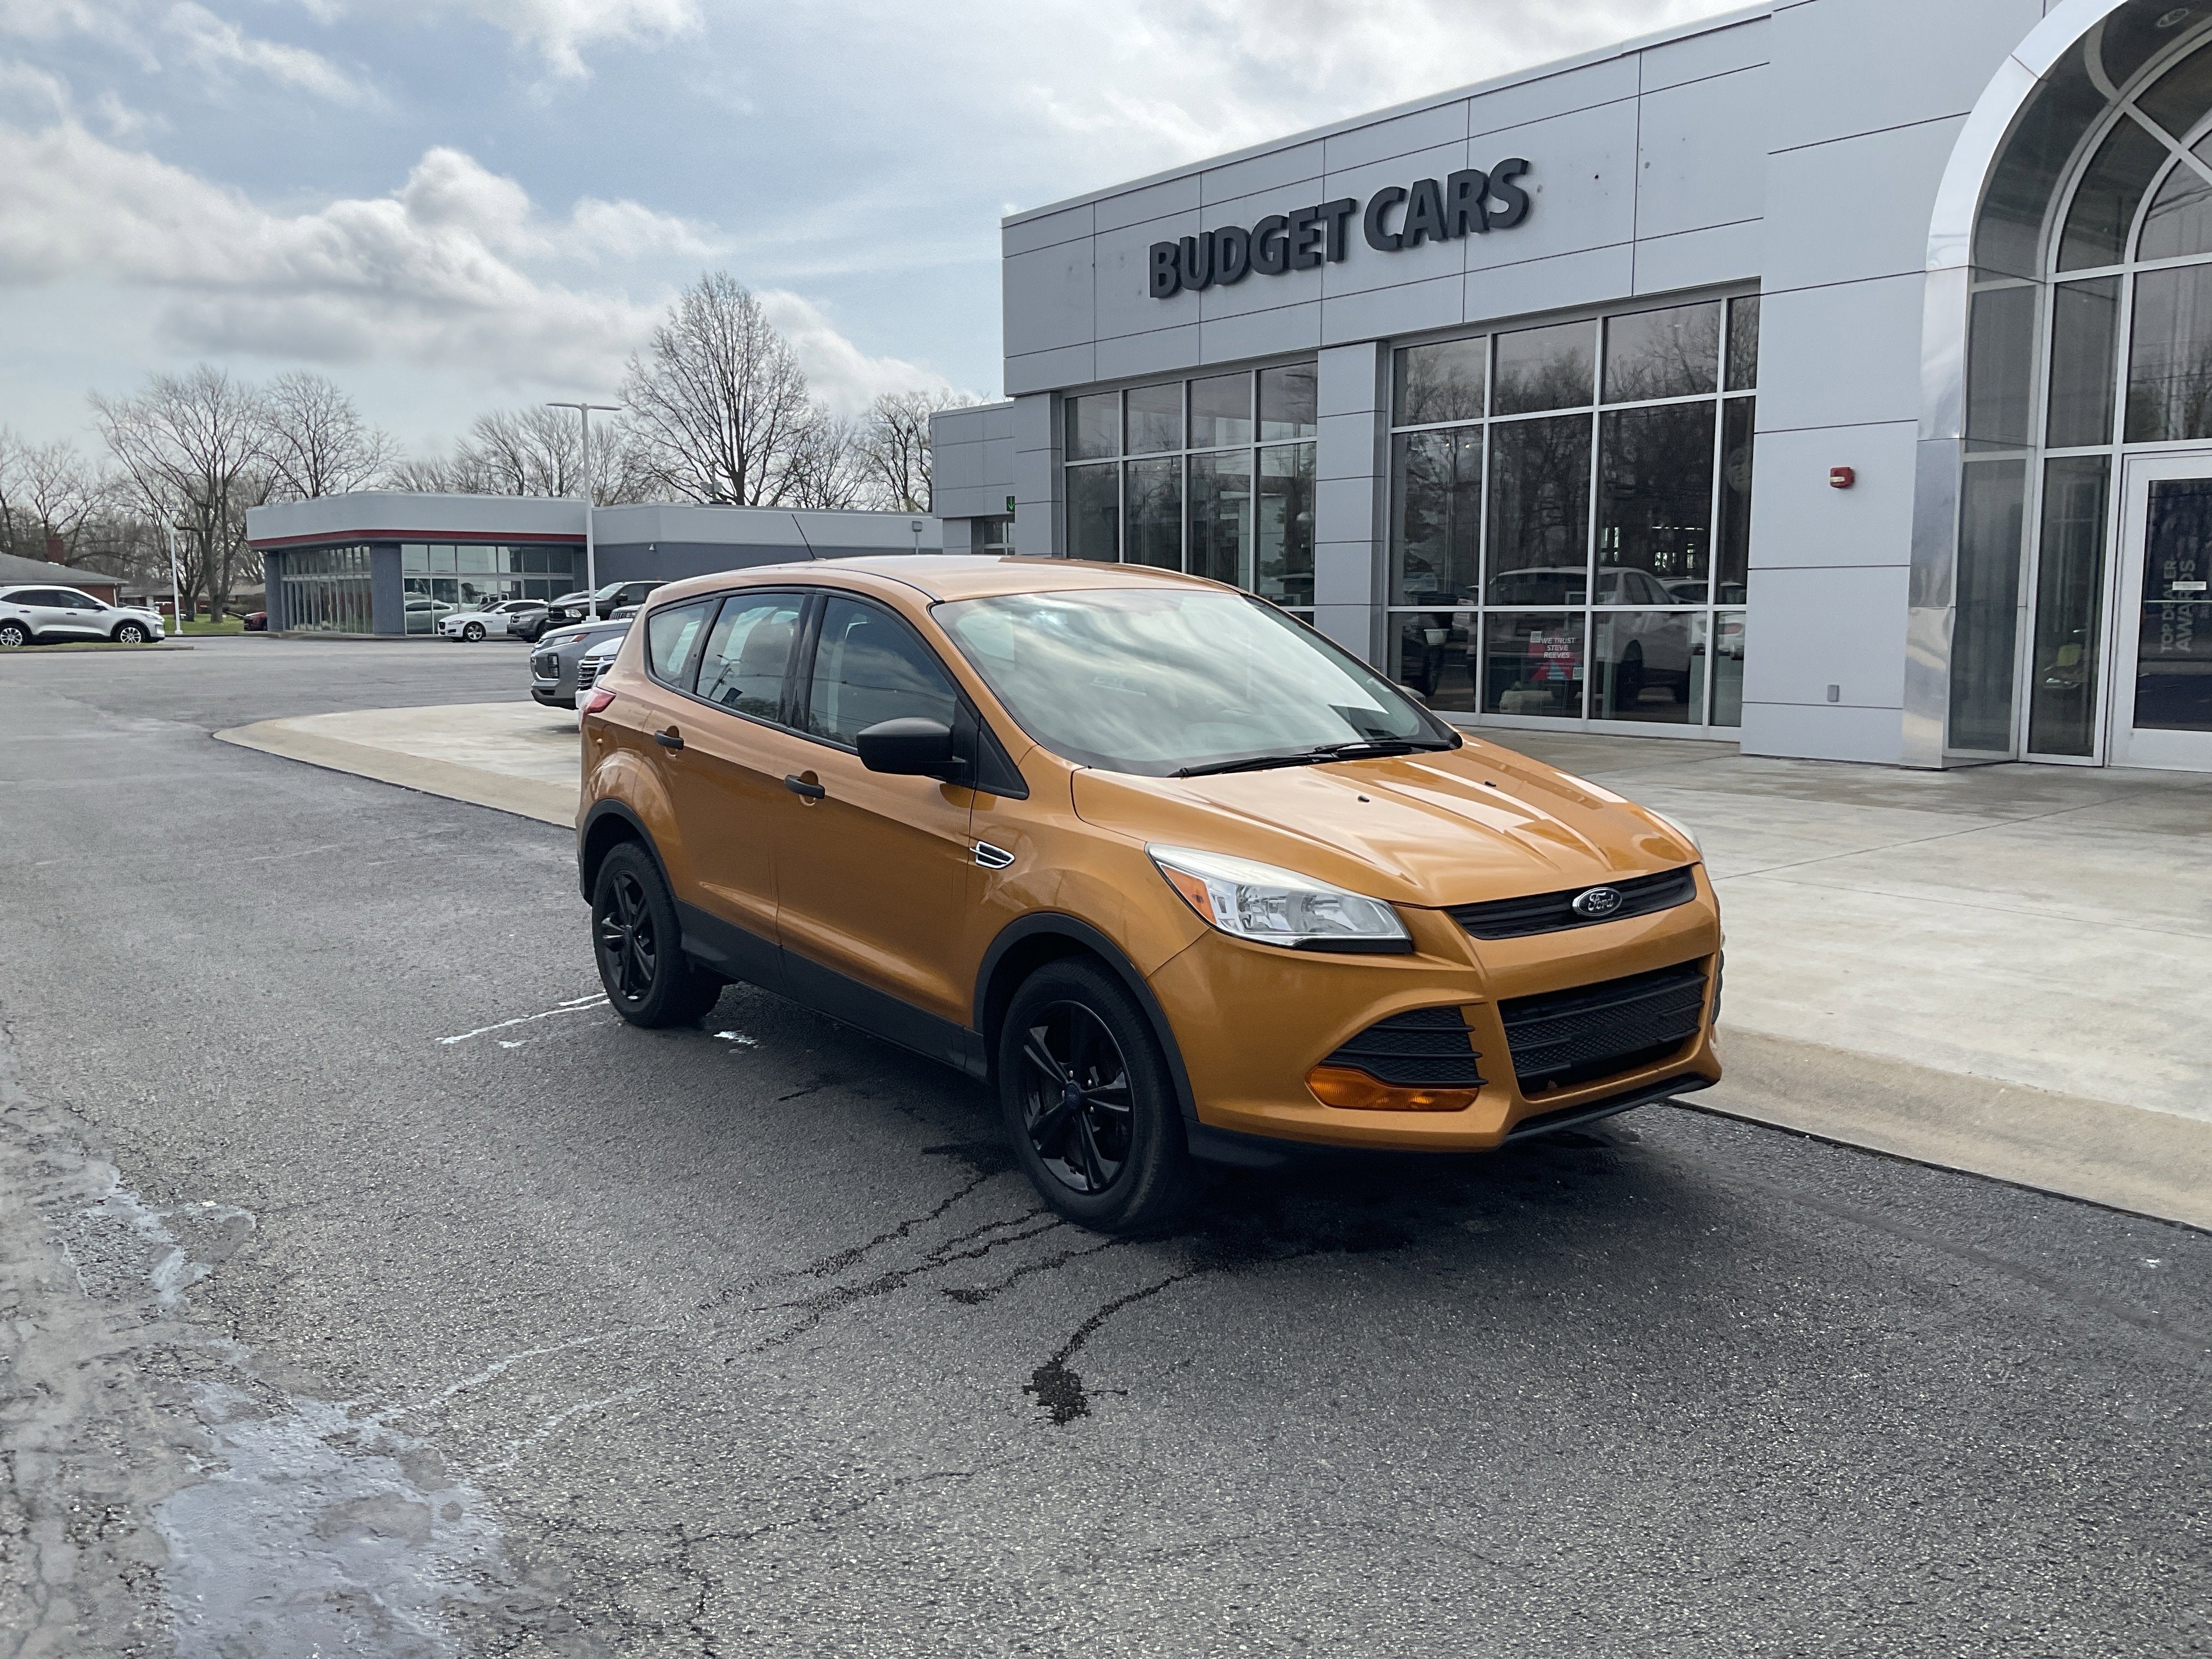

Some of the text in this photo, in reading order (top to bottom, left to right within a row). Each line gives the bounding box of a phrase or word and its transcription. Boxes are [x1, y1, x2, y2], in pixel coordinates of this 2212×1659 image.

[1149, 157, 1531, 298] BUDGET CARS
[2160, 622, 2174, 653] TOP
[1588, 891, 1614, 911] Ford
